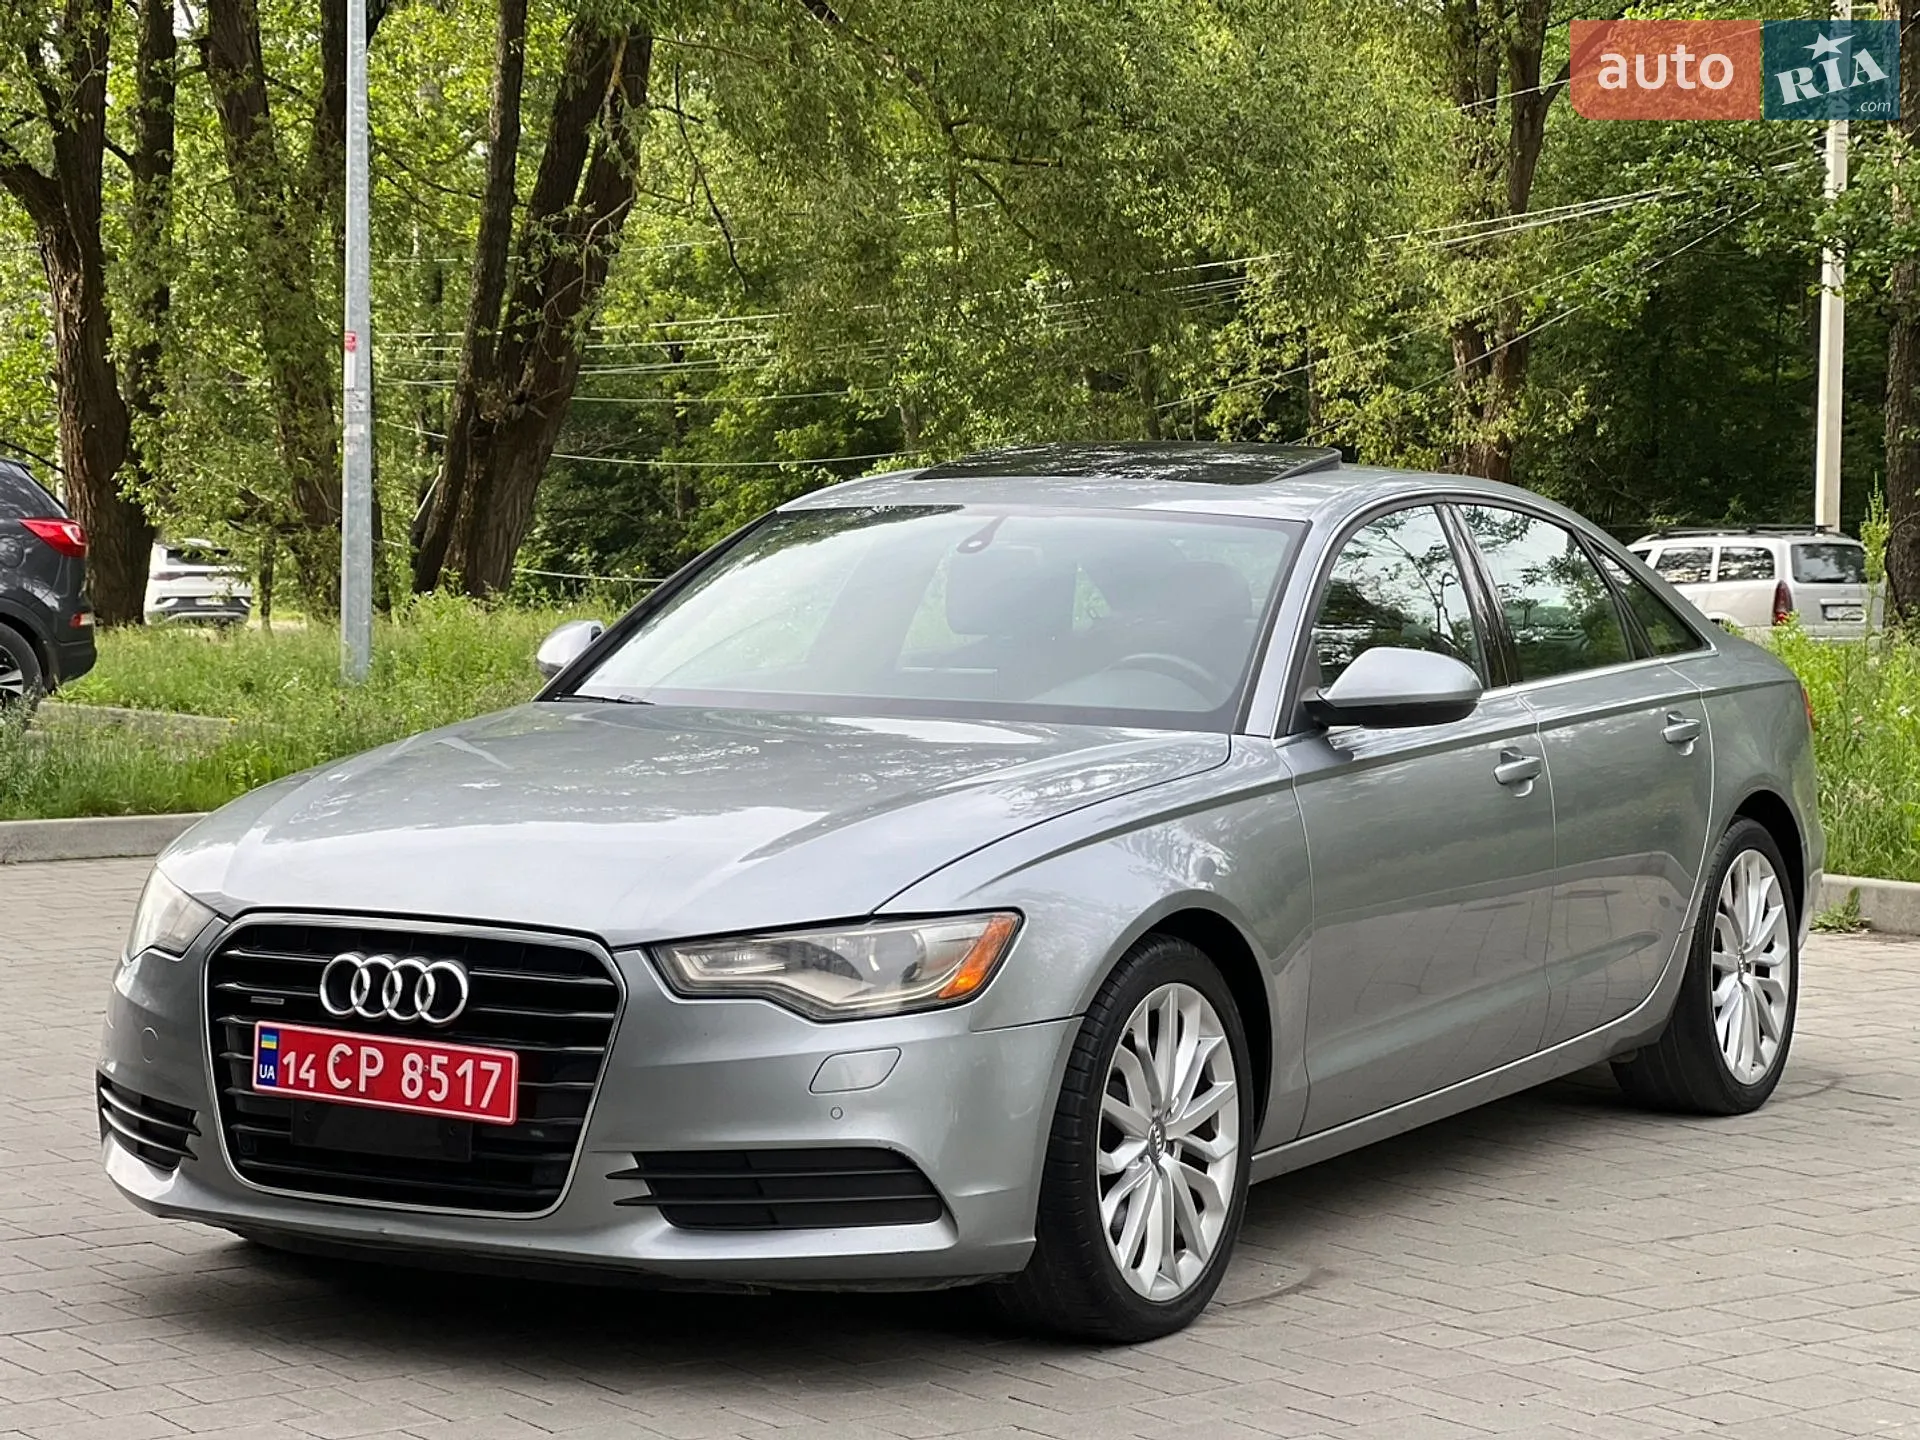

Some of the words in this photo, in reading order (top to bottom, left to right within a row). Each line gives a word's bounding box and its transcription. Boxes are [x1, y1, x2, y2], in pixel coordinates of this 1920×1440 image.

[259, 1064, 275, 1080] UA
[282, 1051, 316, 1088] 14
[326, 1043, 384, 1092] CP
[401, 1052, 502, 1109] 8517
